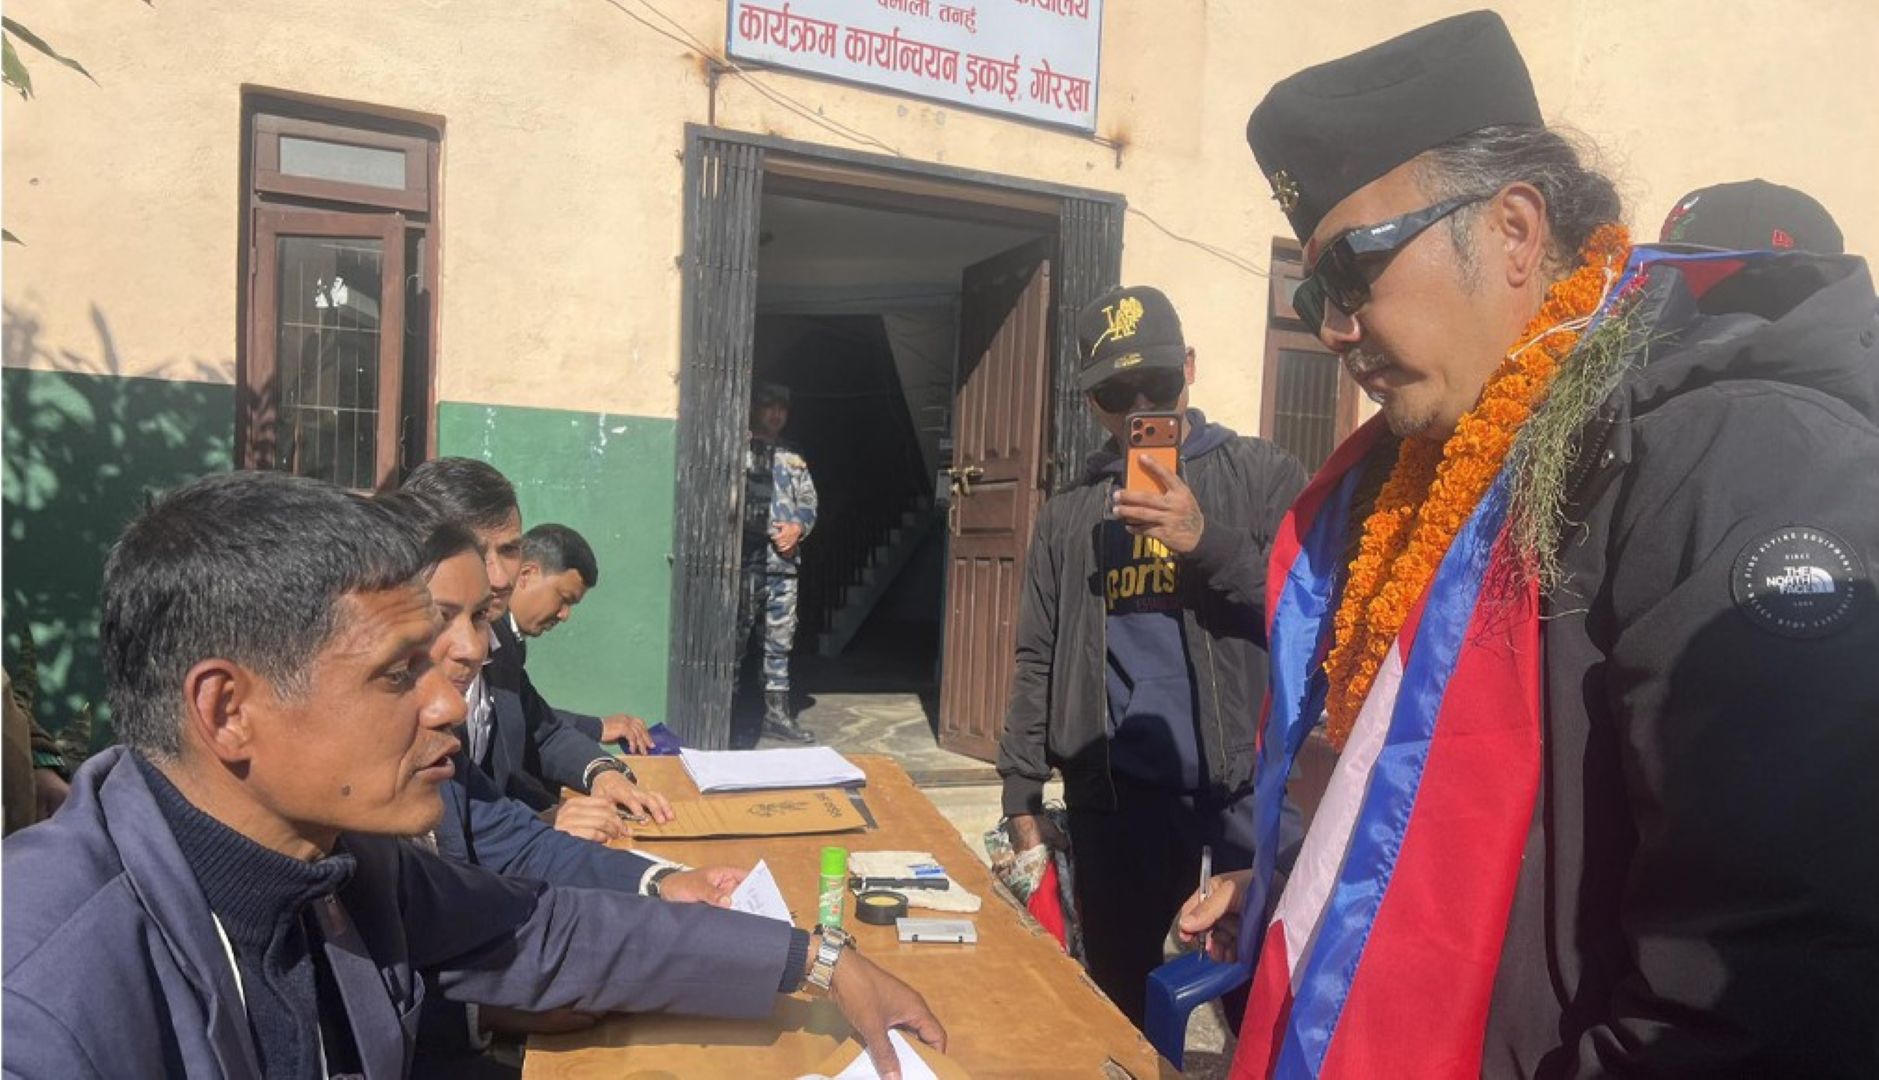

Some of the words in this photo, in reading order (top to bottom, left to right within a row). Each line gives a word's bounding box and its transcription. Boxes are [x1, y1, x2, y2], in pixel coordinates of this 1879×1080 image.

[739, 2, 838, 59] कार्यक्रम
[844, 26, 960, 84] कार्यान्वयन
[1030, 58, 1091, 112] गोरखा
[1783, 566, 1810, 577] THE
[1766, 575, 1811, 587] NORTH
